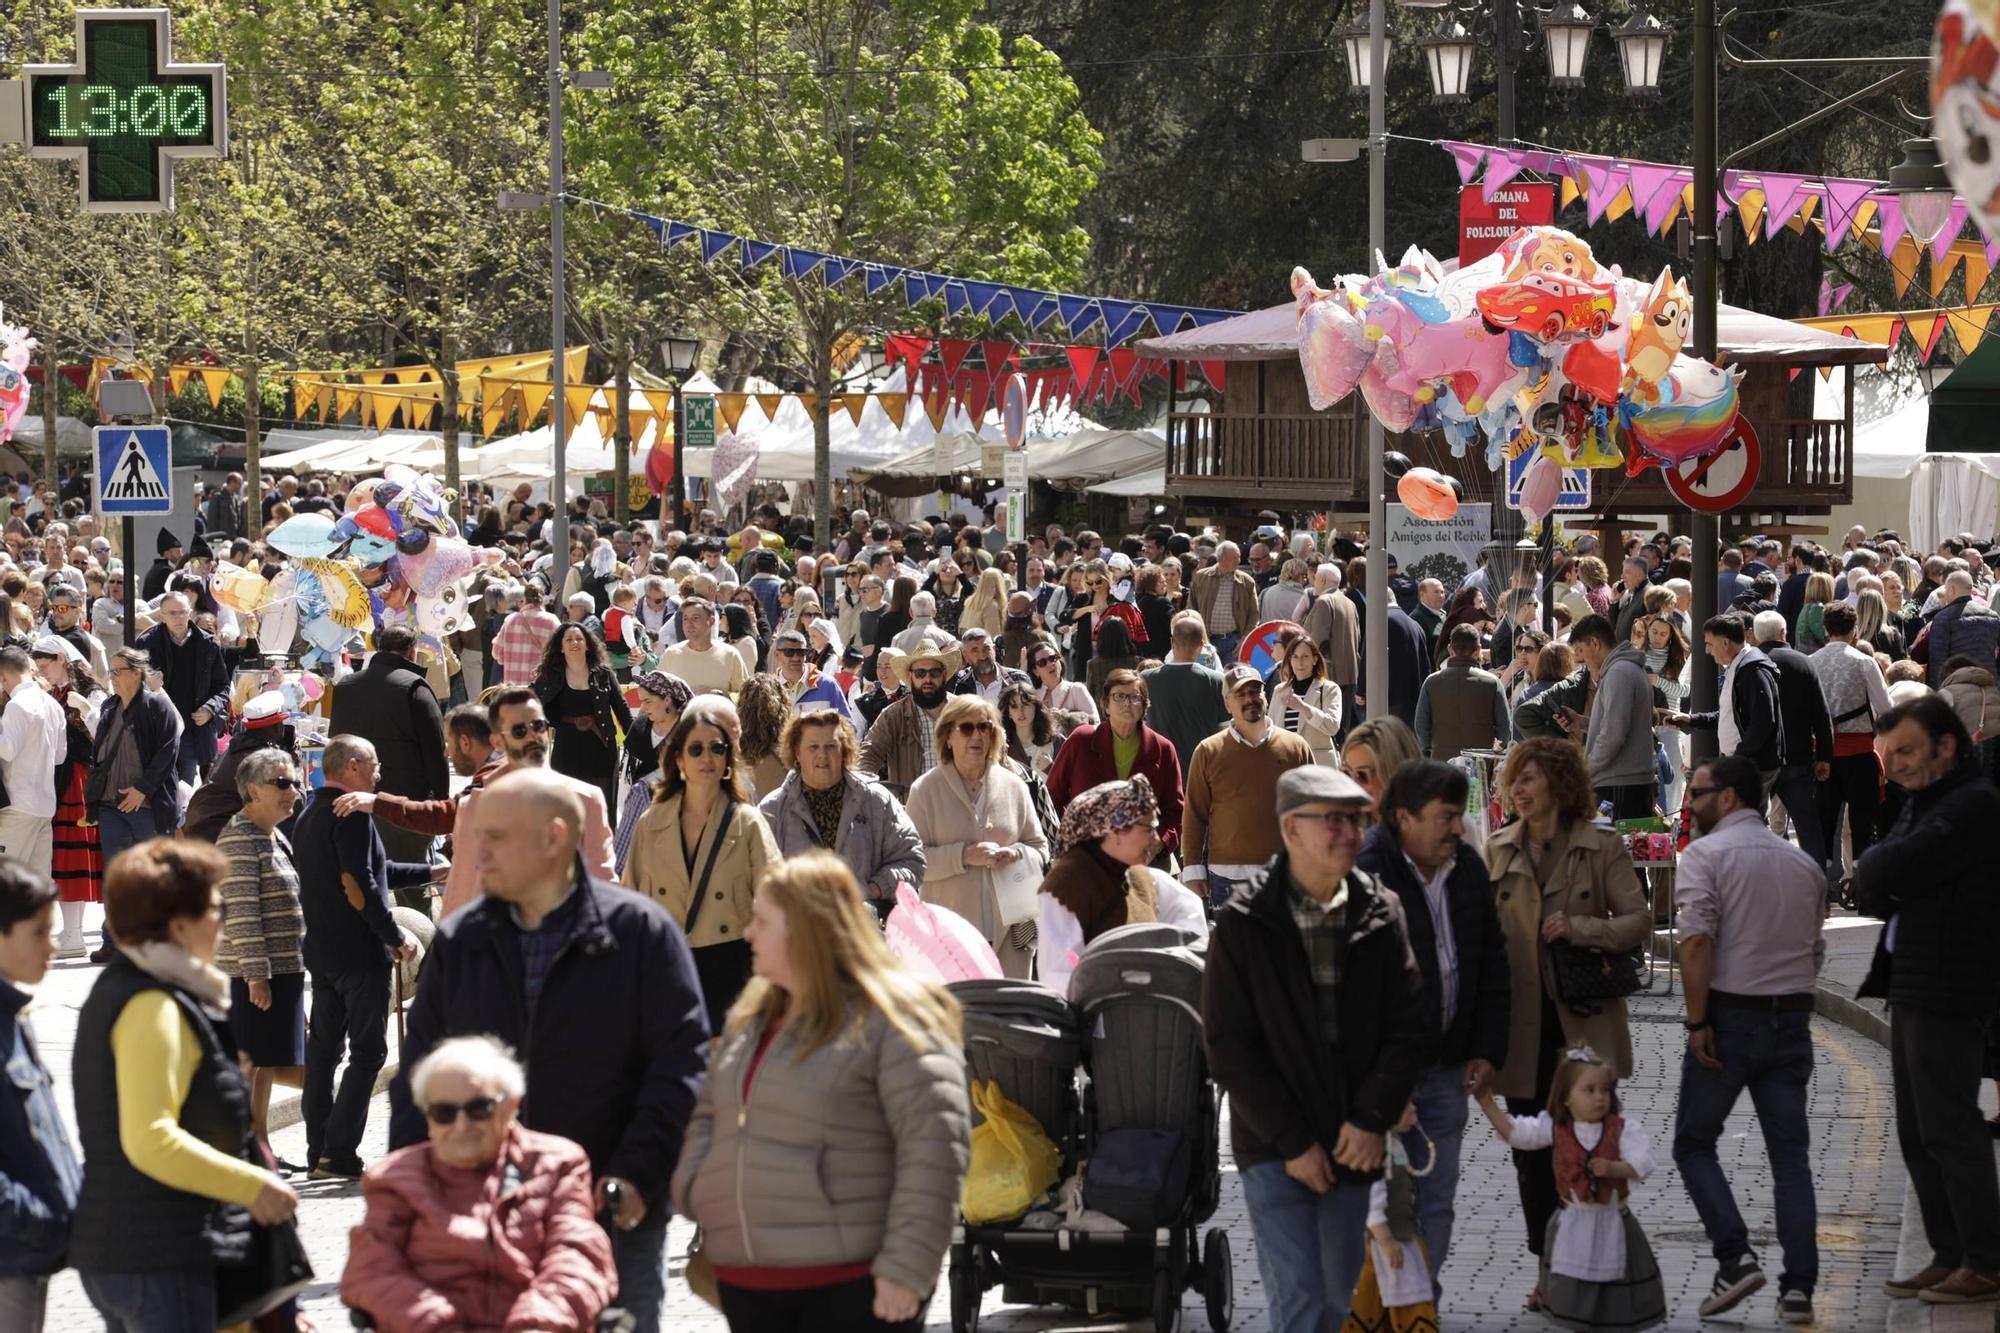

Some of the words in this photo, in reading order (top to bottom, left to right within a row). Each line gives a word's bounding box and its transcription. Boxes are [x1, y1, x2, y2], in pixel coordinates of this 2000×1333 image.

[48, 85, 206, 137] 13:00
[1498, 207, 1519, 220] DEL
[1466, 226, 1517, 239] FOLCLORE
[1391, 531, 1432, 546] Amigos
[1454, 531, 1486, 542] Roble
